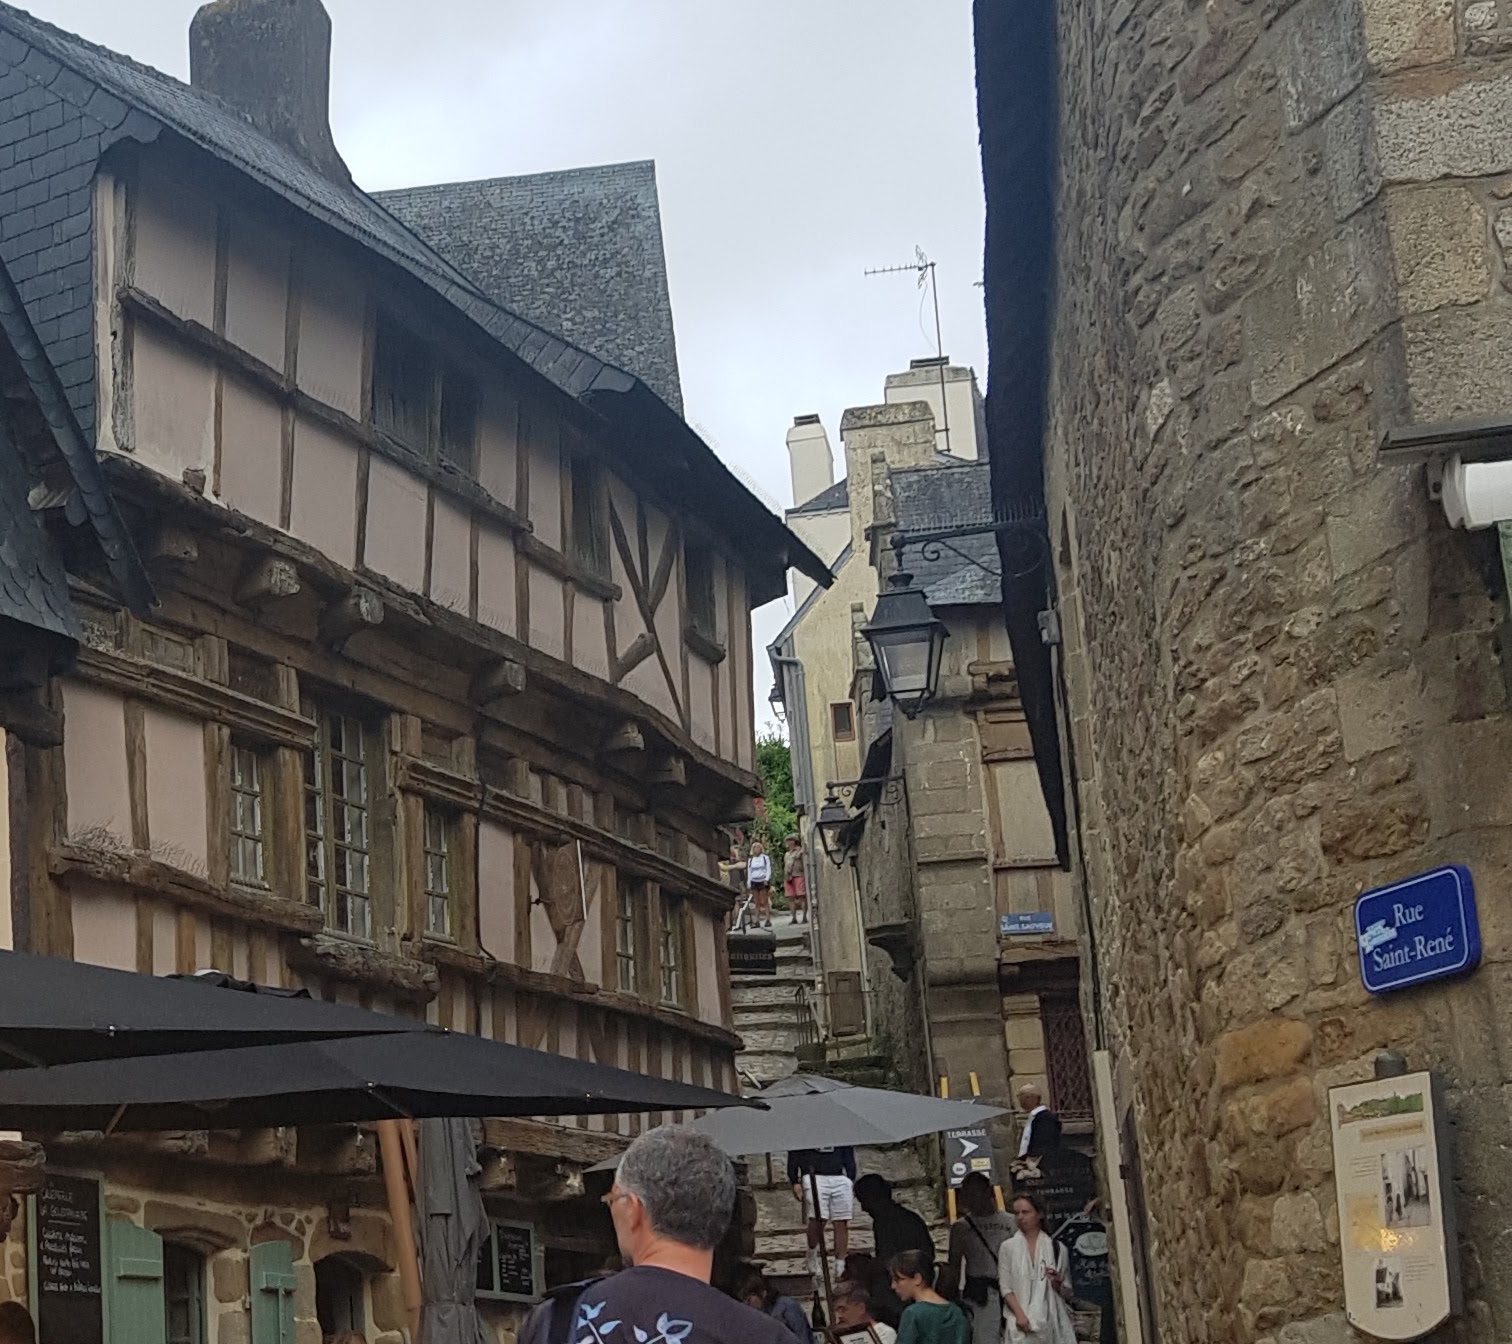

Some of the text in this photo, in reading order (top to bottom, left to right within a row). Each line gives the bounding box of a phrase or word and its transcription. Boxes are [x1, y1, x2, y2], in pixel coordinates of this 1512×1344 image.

[1392, 903, 1424, 928] Rue
[1372, 926, 1455, 972] Saint-René
[947, 1128, 987, 1139] TERRASSE
